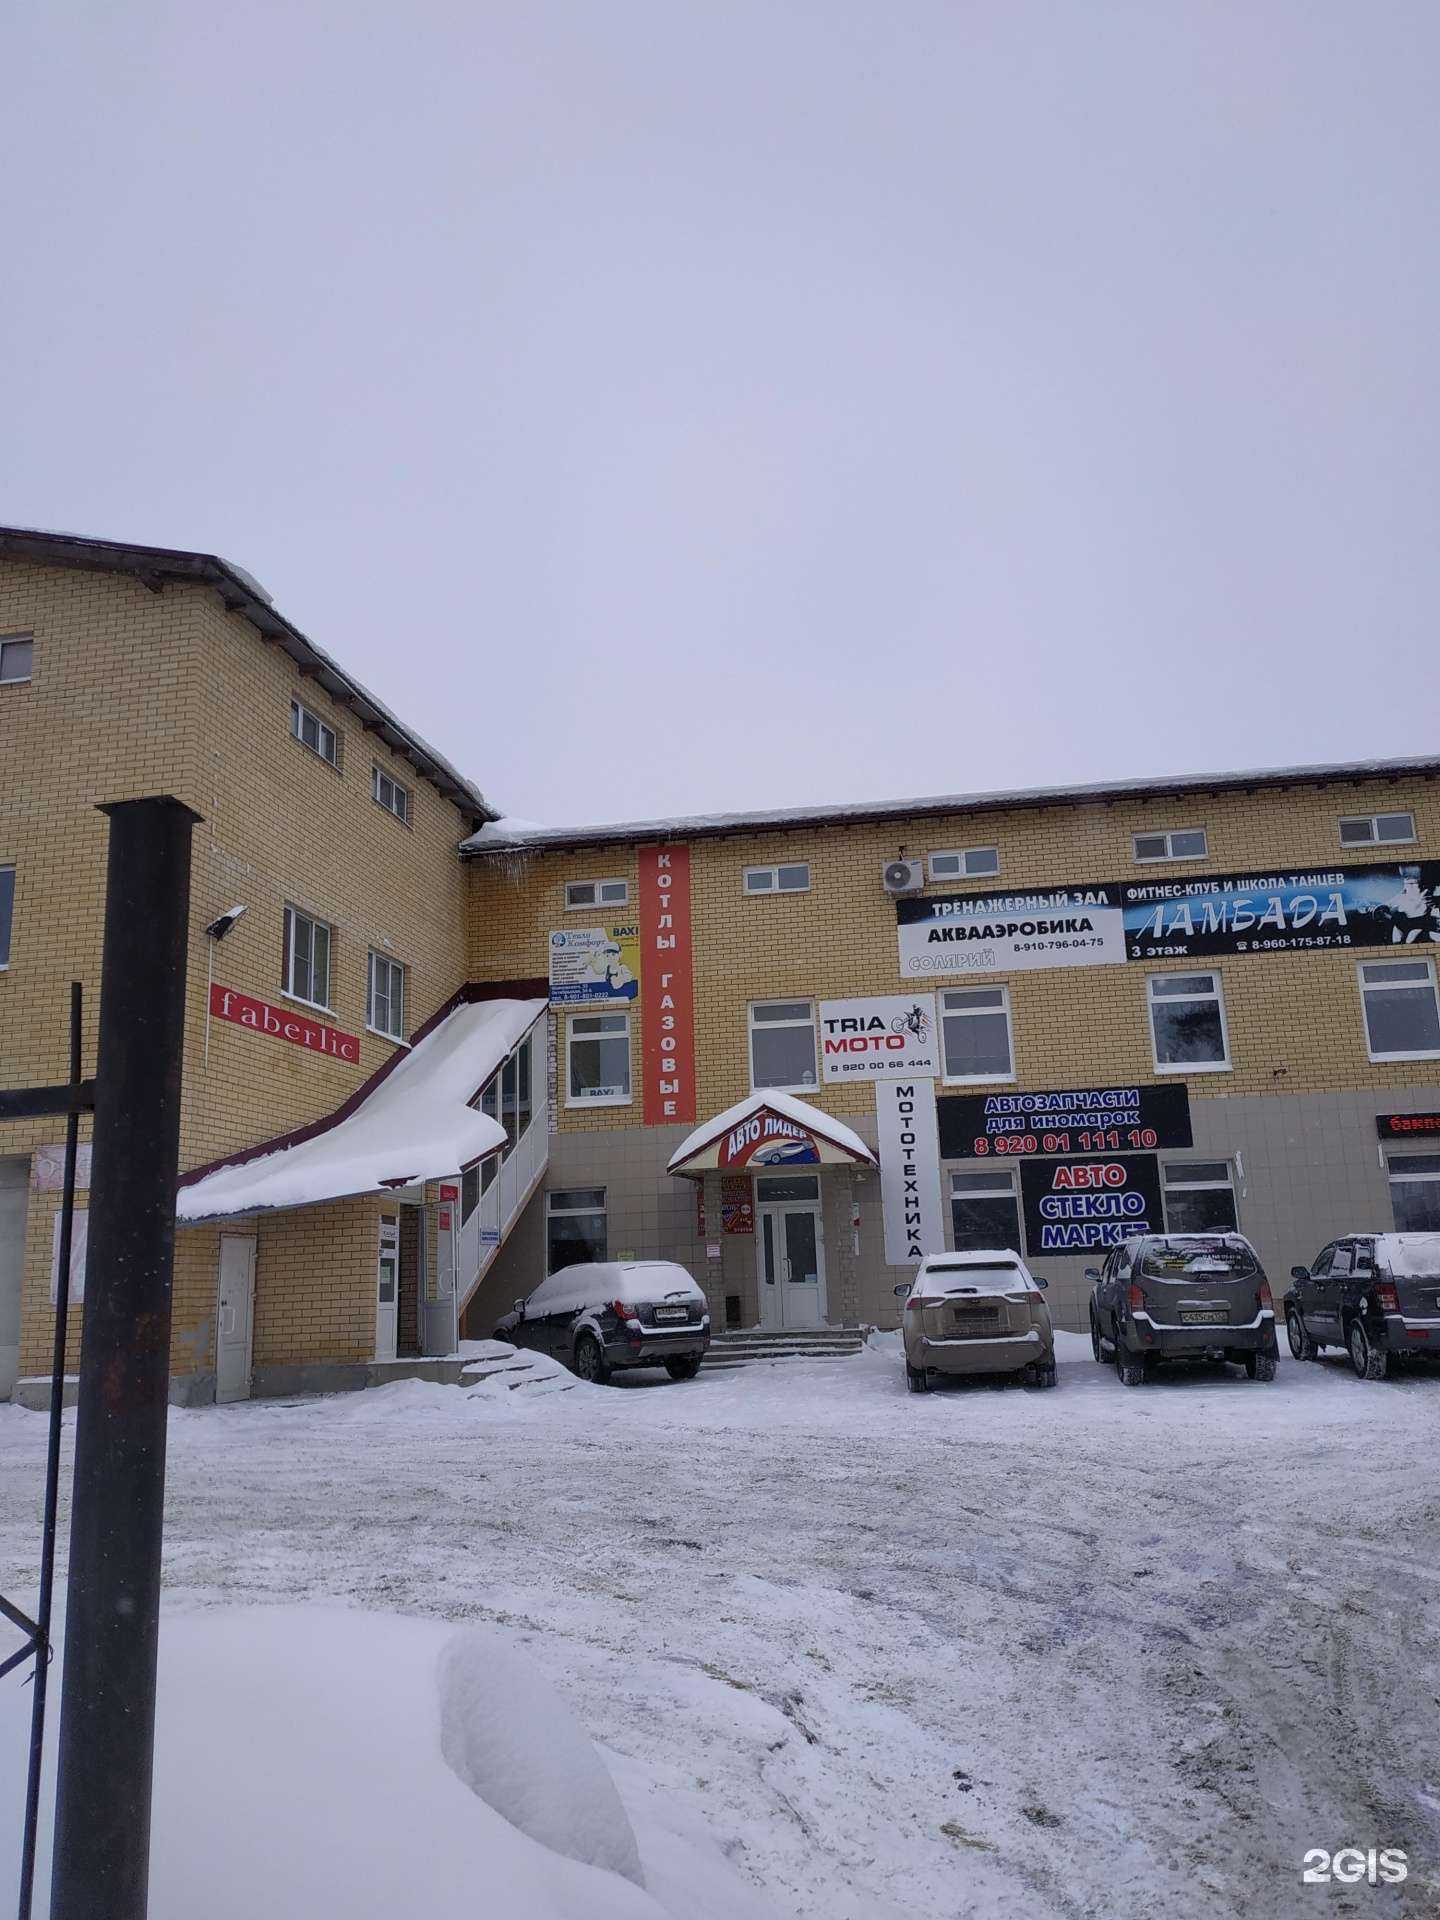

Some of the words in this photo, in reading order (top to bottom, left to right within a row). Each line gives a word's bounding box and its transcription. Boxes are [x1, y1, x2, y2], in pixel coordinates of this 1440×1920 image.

[1127, 882, 1219, 900] ФИТНЕС-КЛУБ
[1223, 881, 1233, 892] И
[1237, 877, 1286, 892] ШКОЛА
[1290, 873, 1345, 888] ТАНЦЕВ
[656, 853, 676, 949] КОТЛЫ
[932, 891, 1069, 918] ТРЕНАЖЕРНЫЙ
[1074, 890, 1109, 906] ЗАЛ
[612, 927, 638, 937] BAXI
[927, 917, 1094, 943] АКВААЭРОБИКА
[1251, 934, 1352, 950] 8-960-175-87-18
[1013, 937, 1104, 952] 8-910-796-04-75
[1131, 945, 1141, 957] 3
[1146, 945, 1188, 956] этаж
[908, 948, 996, 971] СОЛЯРИЙ
[221, 992, 353, 1059] faberlic
[823, 1016, 886, 1034] TRIA
[659, 973, 679, 1116] ГАЗОВЫЕ
[825, 1035, 905, 1054] MOTO
[843, 1063, 865, 1071] 920
[869, 1062, 885, 1070] 00
[889, 1060, 904, 1068] 66
[908, 1059, 931, 1067] 444
[984, 1089, 1140, 1114] АВТОЗАПЧАСТИ
[986, 1117, 1025, 1133] для
[1031, 1110, 1141, 1129] иномарок
[728, 1119, 760, 1162] АВТО
[974, 1137, 989, 1156] 8
[994, 1134, 1038, 1154] 920
[1042, 1133, 1070, 1152] 01
[1078, 1130, 1119, 1150] 111
[1128, 1129, 1157, 1148] 10
[896, 1086, 923, 1257] МОТОТЕХНИКА
[1053, 1163, 1127, 1190] АВТО
[1039, 1191, 1146, 1219] СТЕКЛО
